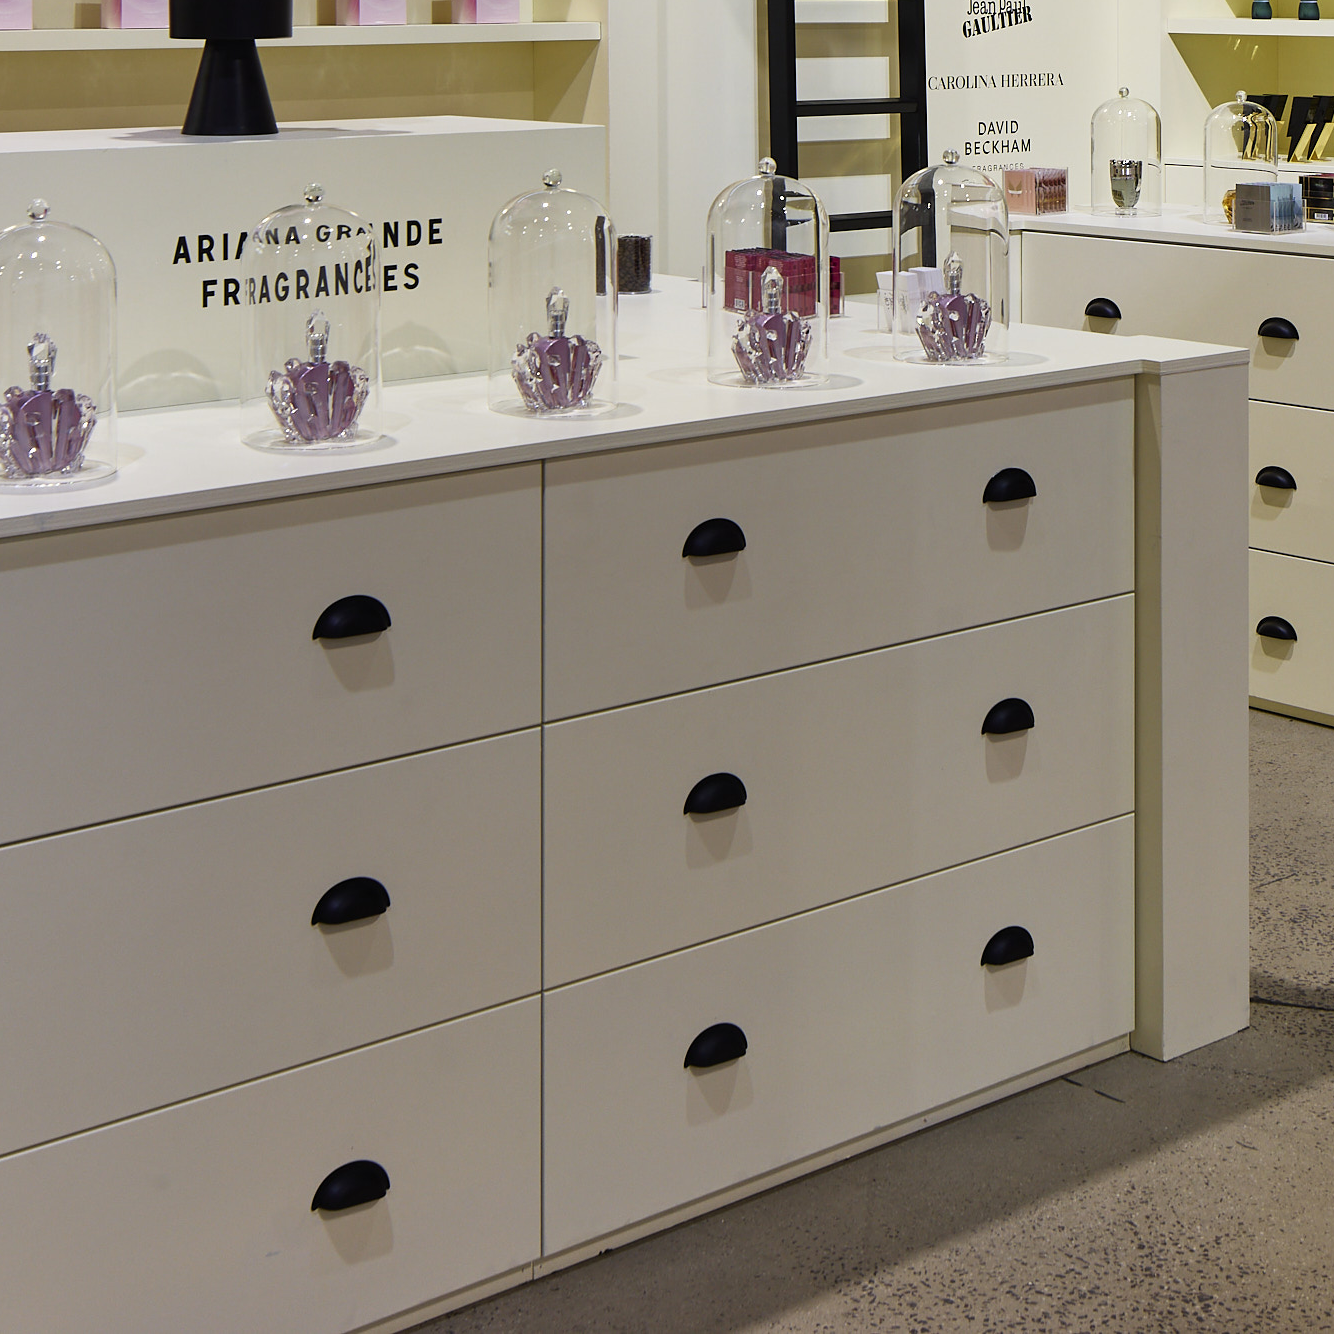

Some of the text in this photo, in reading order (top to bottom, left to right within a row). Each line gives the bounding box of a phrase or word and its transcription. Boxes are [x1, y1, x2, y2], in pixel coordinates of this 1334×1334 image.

[963, 6, 1032, 38] GAULTIER
[928, 72, 1064, 90] CAROLINA HERRERA
[978, 120, 1019, 136] DAVID
[964, 138, 1031, 156] BECKHAM
[972, 163, 1024, 172] FRAGRANCES
[317, 218, 443, 248] GRANDE
